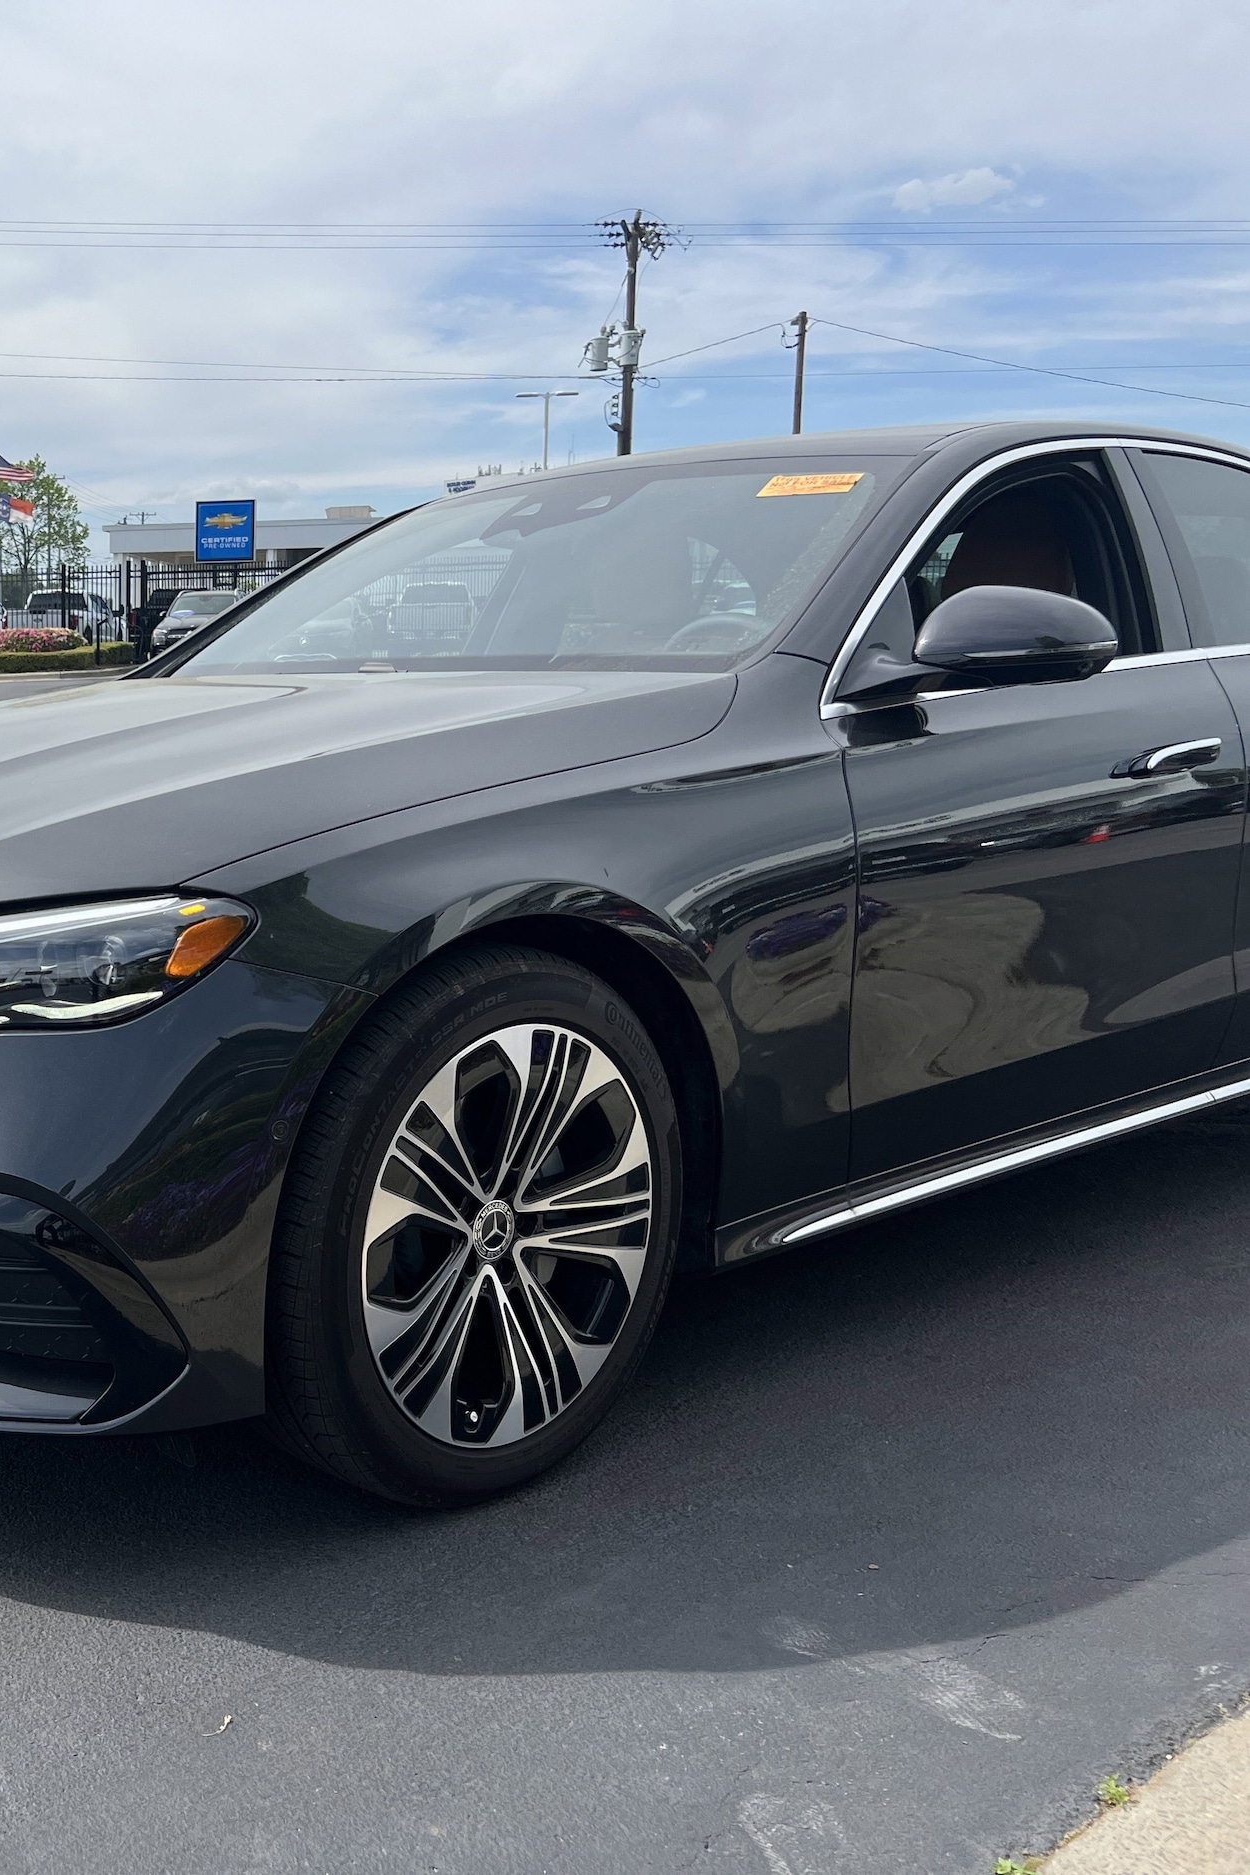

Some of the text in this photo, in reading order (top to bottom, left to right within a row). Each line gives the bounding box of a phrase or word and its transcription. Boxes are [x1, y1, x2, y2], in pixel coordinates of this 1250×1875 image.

[200, 536, 249, 544] CERTIFIED
[430, 1013, 466, 1047] SSR
[469, 991, 509, 1017] MOE
[604, 1000, 664, 1088] Continental
[480, 1202, 509, 1219] MERCEDES
